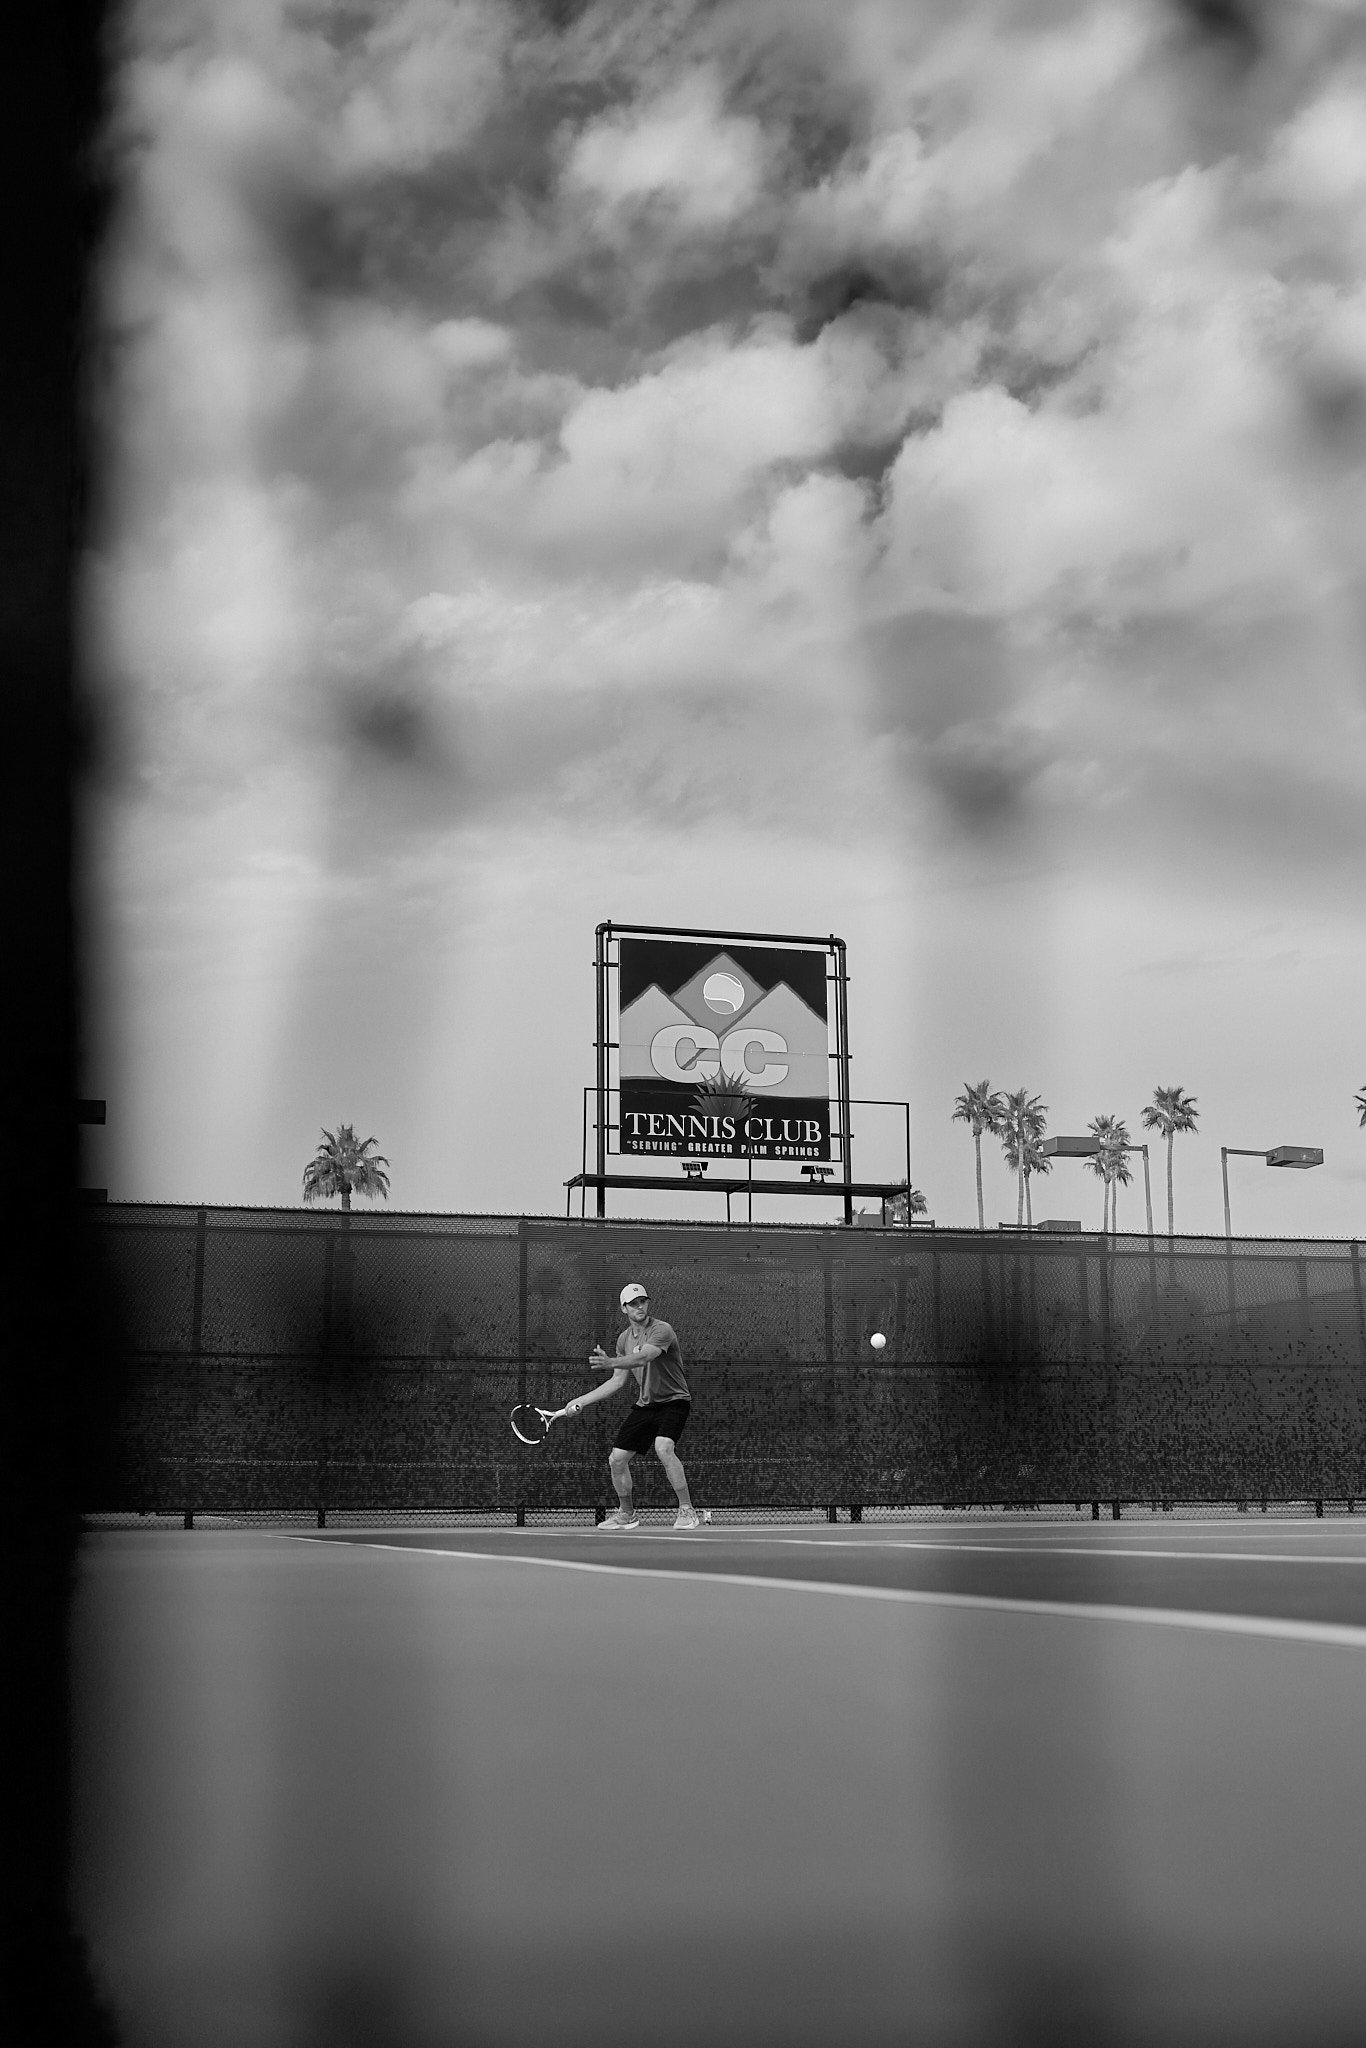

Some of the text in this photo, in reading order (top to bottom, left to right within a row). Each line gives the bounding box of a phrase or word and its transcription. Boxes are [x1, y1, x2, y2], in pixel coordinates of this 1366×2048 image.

[650, 1024, 789, 1087] CC
[625, 1112, 822, 1143] TENNIS CLUB
[688, 1142, 733, 1153] GREATER
[741, 1144, 767, 1155] PALM
[775, 1146, 820, 1157] SPRINGS
